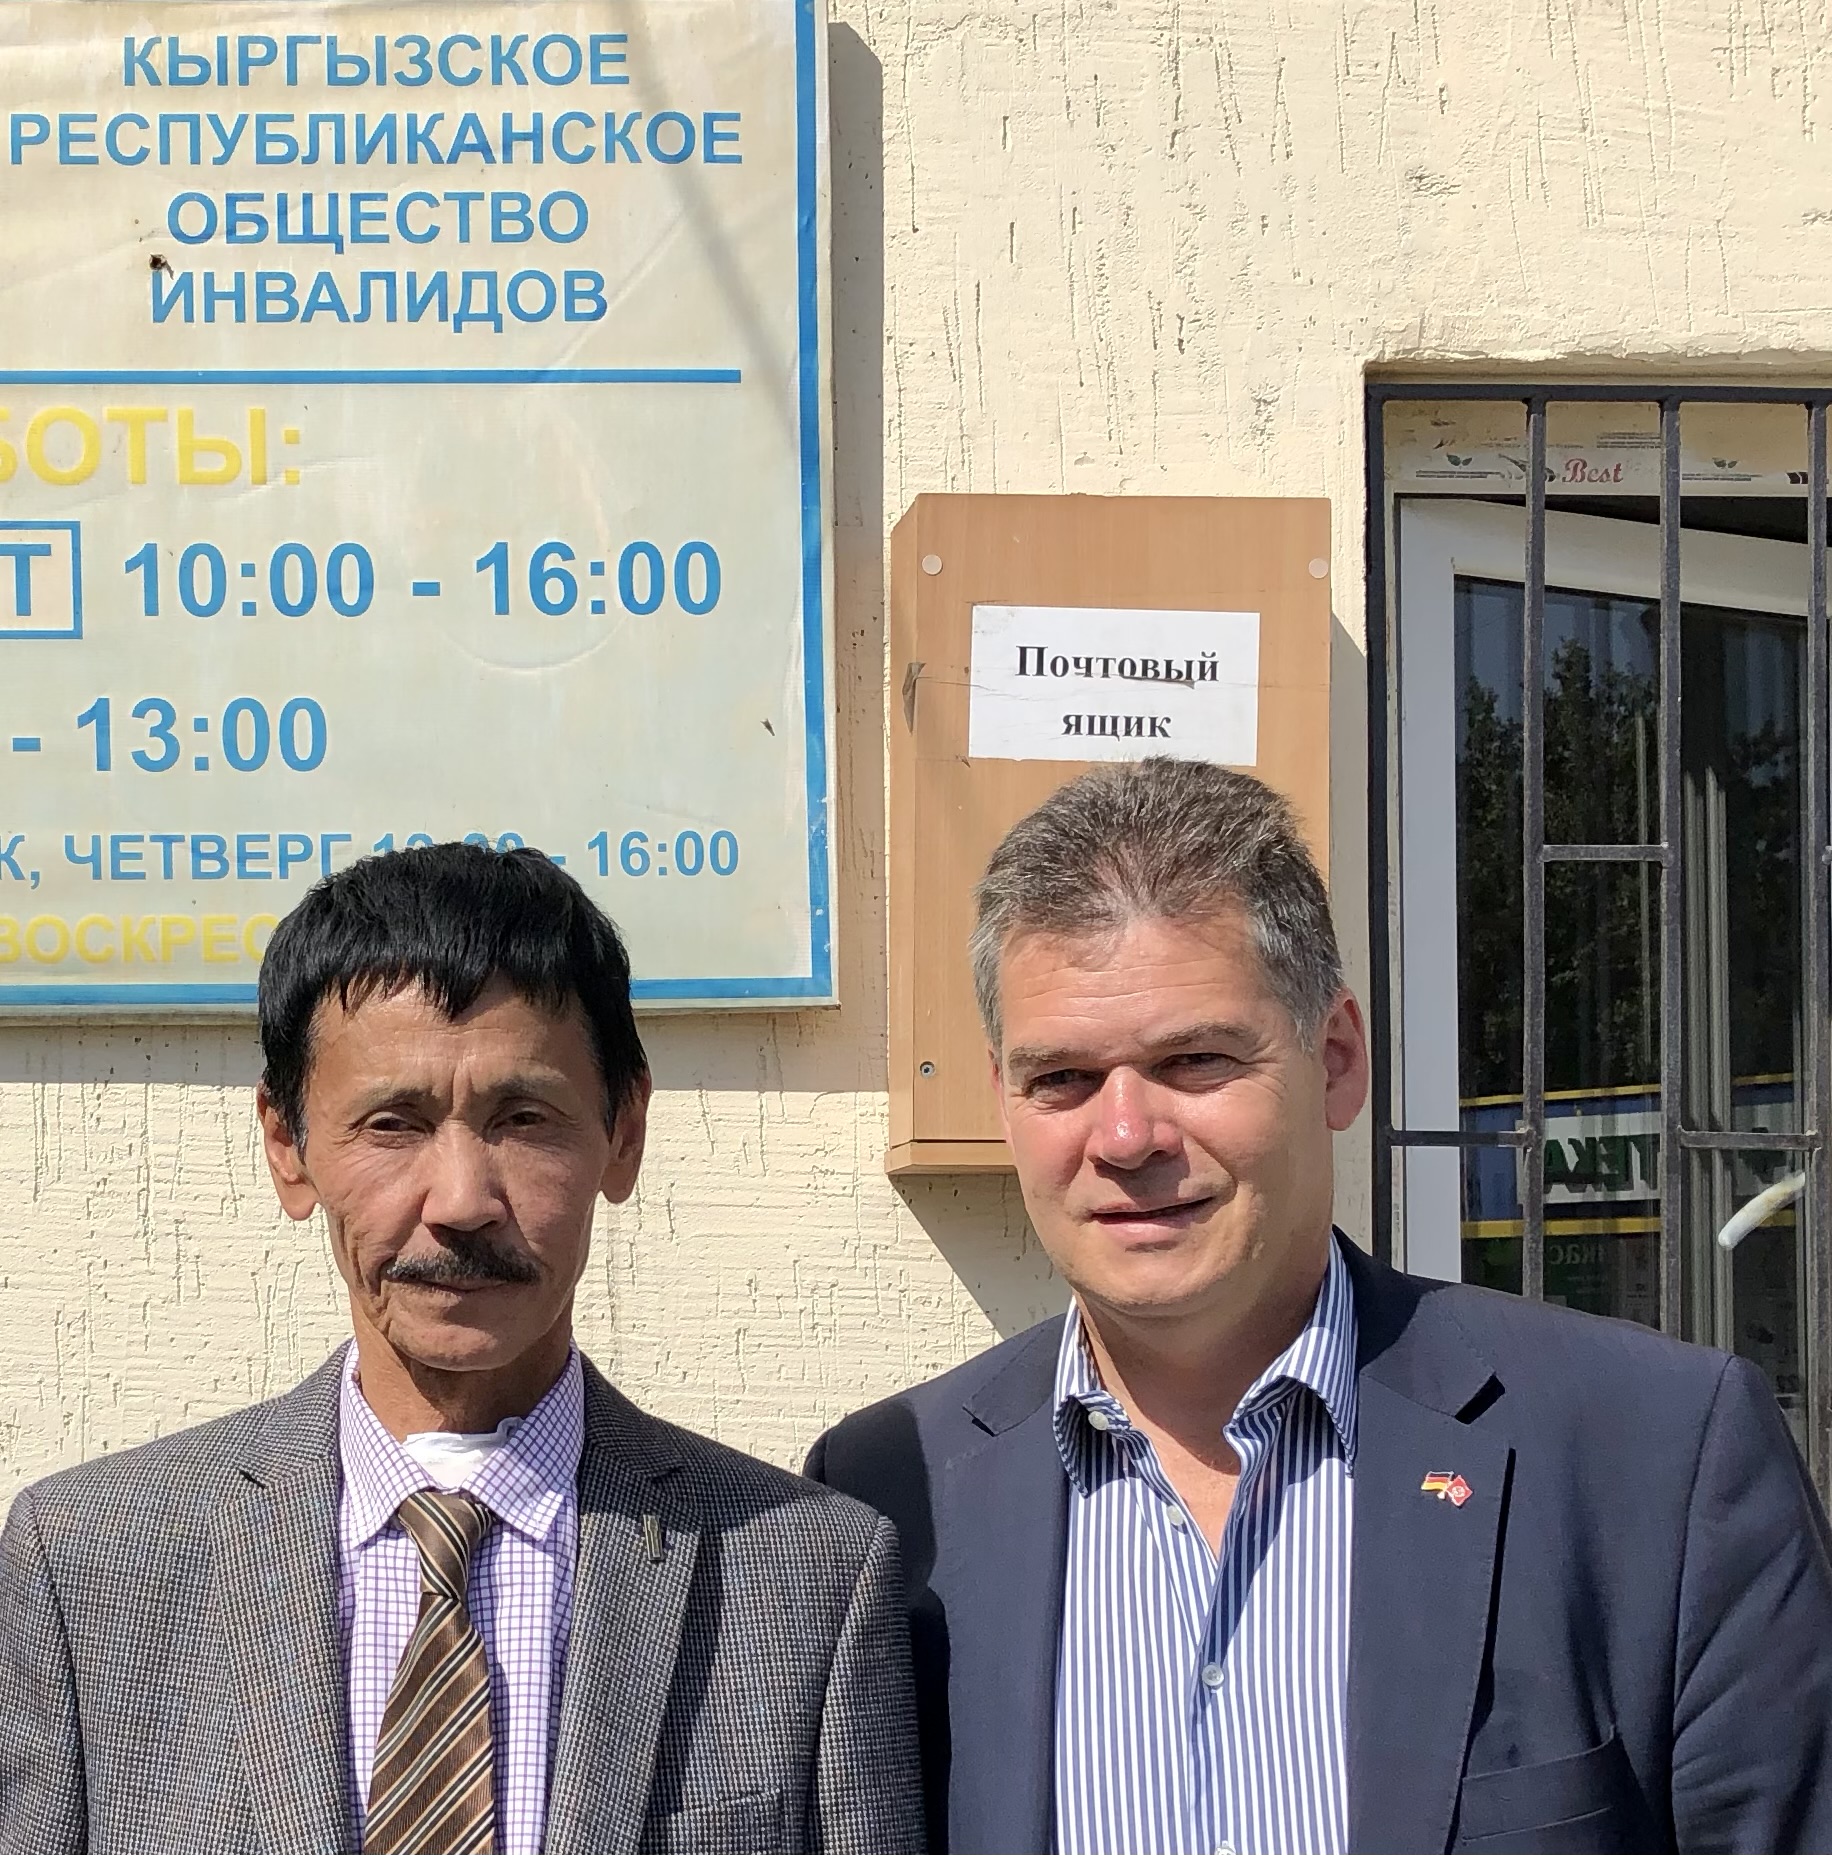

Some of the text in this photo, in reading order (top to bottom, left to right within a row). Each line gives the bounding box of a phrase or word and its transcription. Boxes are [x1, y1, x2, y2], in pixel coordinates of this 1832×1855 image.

[123, 34, 629, 87] КЫРГЫЗСКОЕ
[9, 111, 743, 166] РЕСПУБЛИКАНСКОЕ
[167, 190, 589, 254] ОБЩЕСТВО
[151, 269, 608, 334] ИНВАЛИДОВ
[1562, 457, 1623, 483] Best
[124, 542, 375, 617] 10:00
[412, 581, 441, 597] -
[475, 541, 722, 616] 16:00
[1016, 645, 1220, 683] Почтовый
[12, 697, 328, 772] - 13:00
[1062, 713, 1171, 741] ящик
[64, 833, 352, 880] ЧЕТВЕРГ
[588, 830, 739, 877] 16:00
